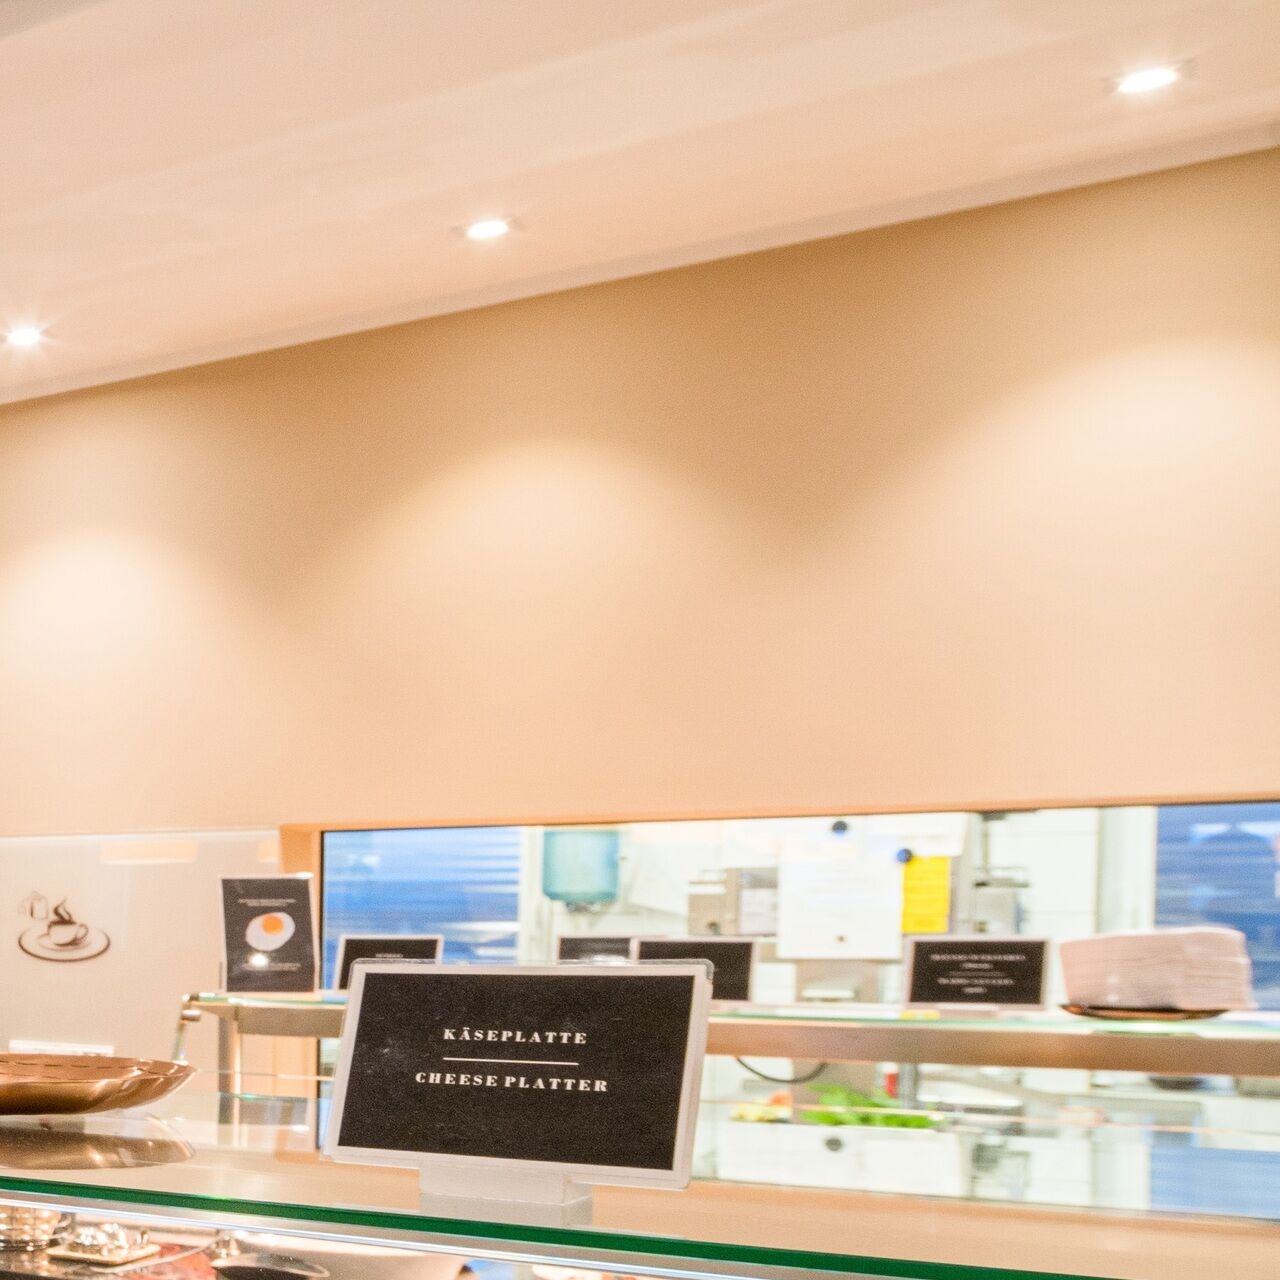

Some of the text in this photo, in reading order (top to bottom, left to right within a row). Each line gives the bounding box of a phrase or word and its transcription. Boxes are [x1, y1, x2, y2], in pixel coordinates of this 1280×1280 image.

[443, 1026, 588, 1044] KÄSEPLATTE
[415, 1072, 608, 1092] CHEESE PLATTER
